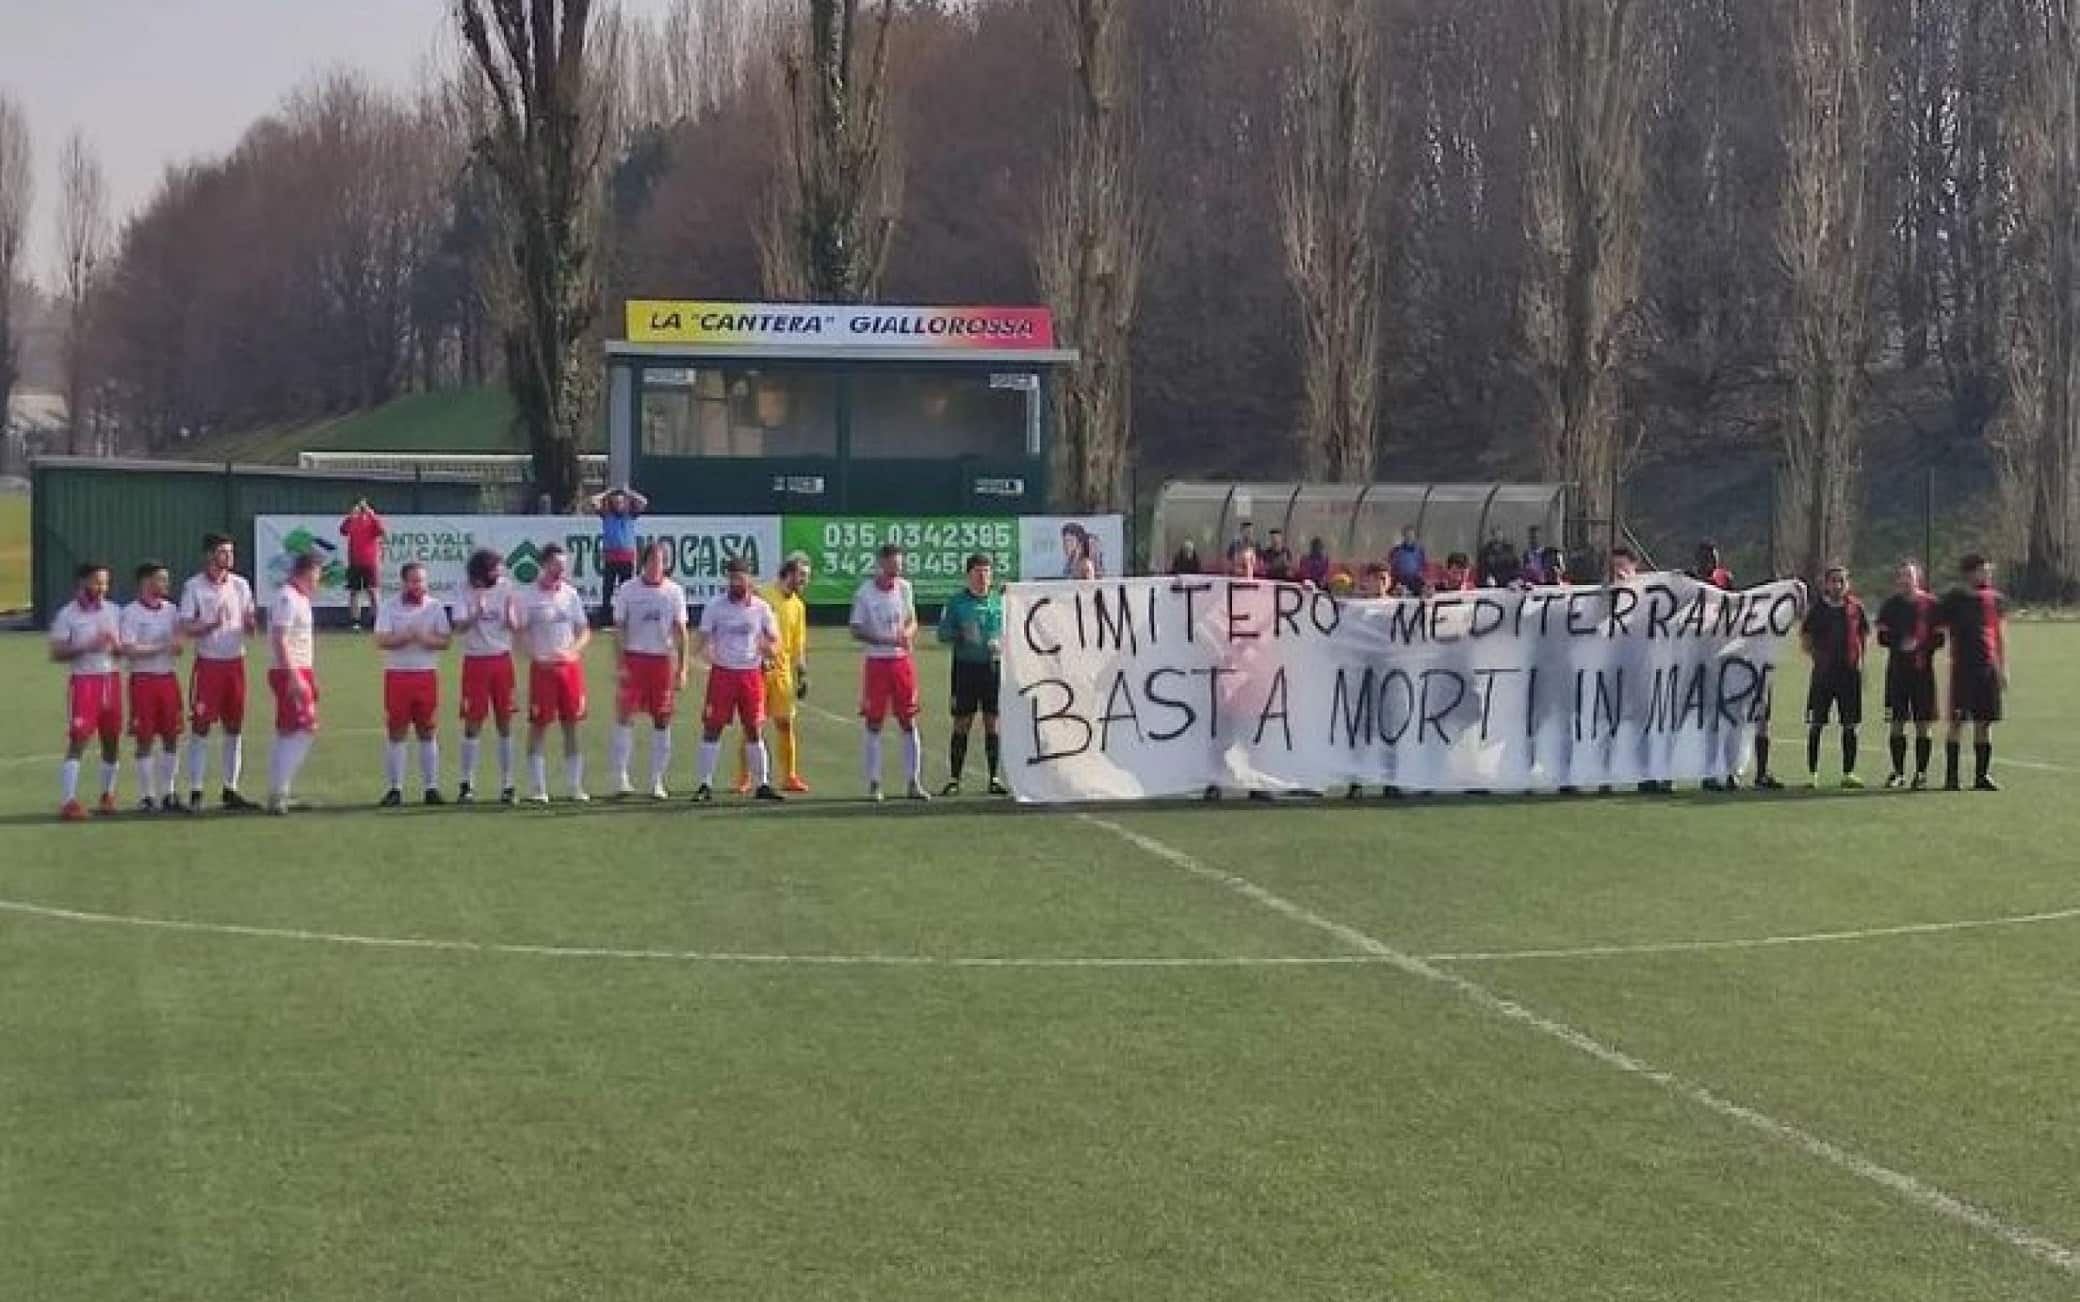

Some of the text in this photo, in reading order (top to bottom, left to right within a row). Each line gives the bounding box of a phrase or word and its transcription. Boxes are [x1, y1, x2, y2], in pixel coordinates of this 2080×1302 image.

[651, 312, 1033, 337] LA "CANTERA" GIALLOROSSA
[1022, 581, 1799, 656] CIMITERO MEDITERRANEO
[1328, 665, 1538, 750] MORTI
[1573, 667, 1624, 741] IN
